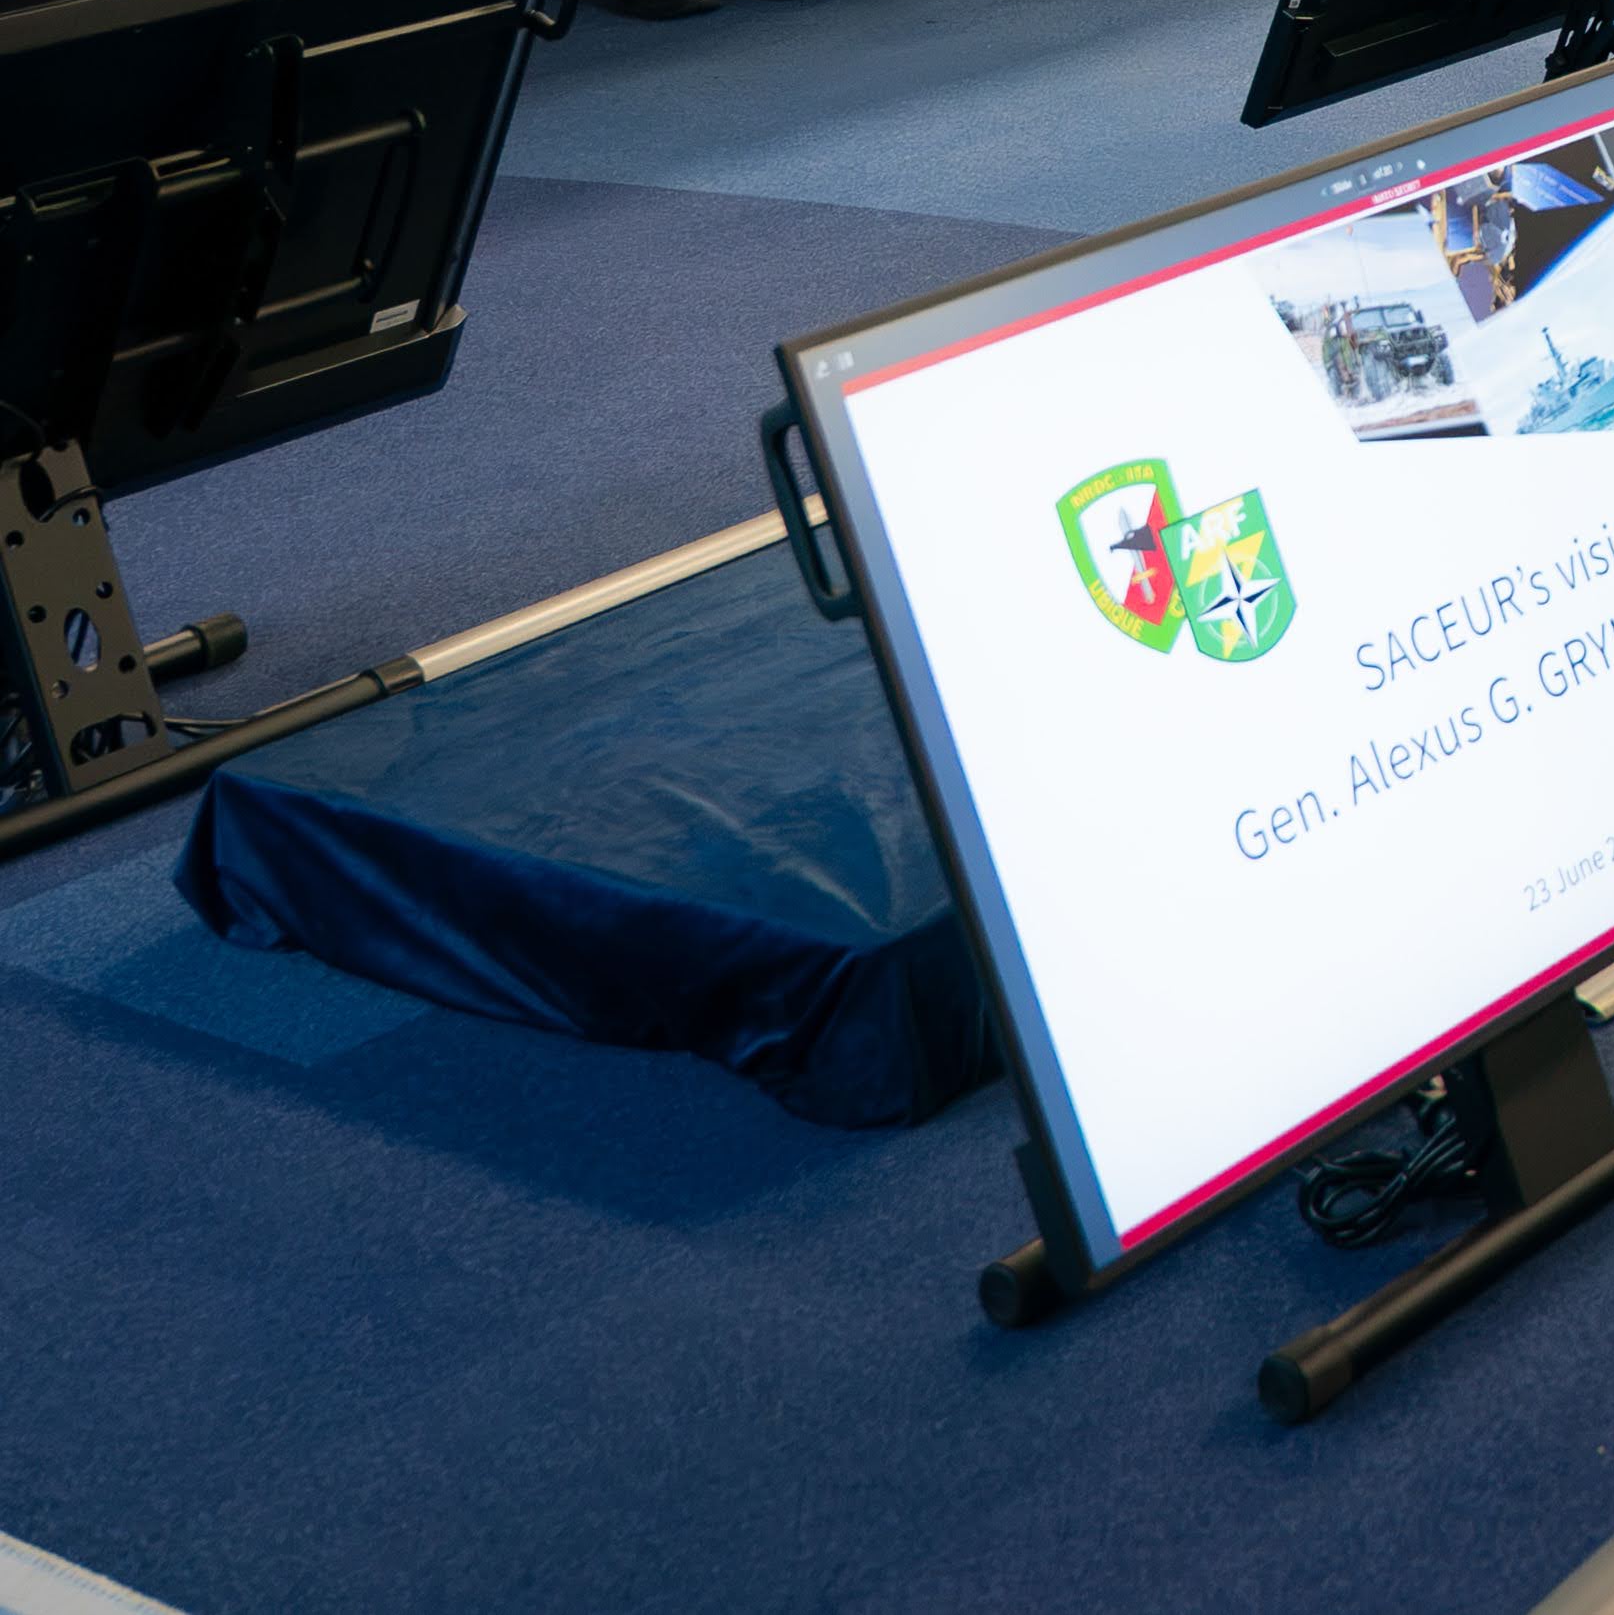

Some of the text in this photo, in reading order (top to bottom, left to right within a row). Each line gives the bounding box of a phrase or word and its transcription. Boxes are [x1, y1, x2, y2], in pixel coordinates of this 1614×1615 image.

[1180, 498, 1247, 561] ARF
[1356, 565, 1551, 691] SACEUR's
[1235, 790, 1339, 860] Gen.
[1349, 707, 1483, 806] Alexus
[1489, 676, 1533, 724] G.
[1523, 879, 1552, 912] 23
[1556, 850, 1605, 895] June
